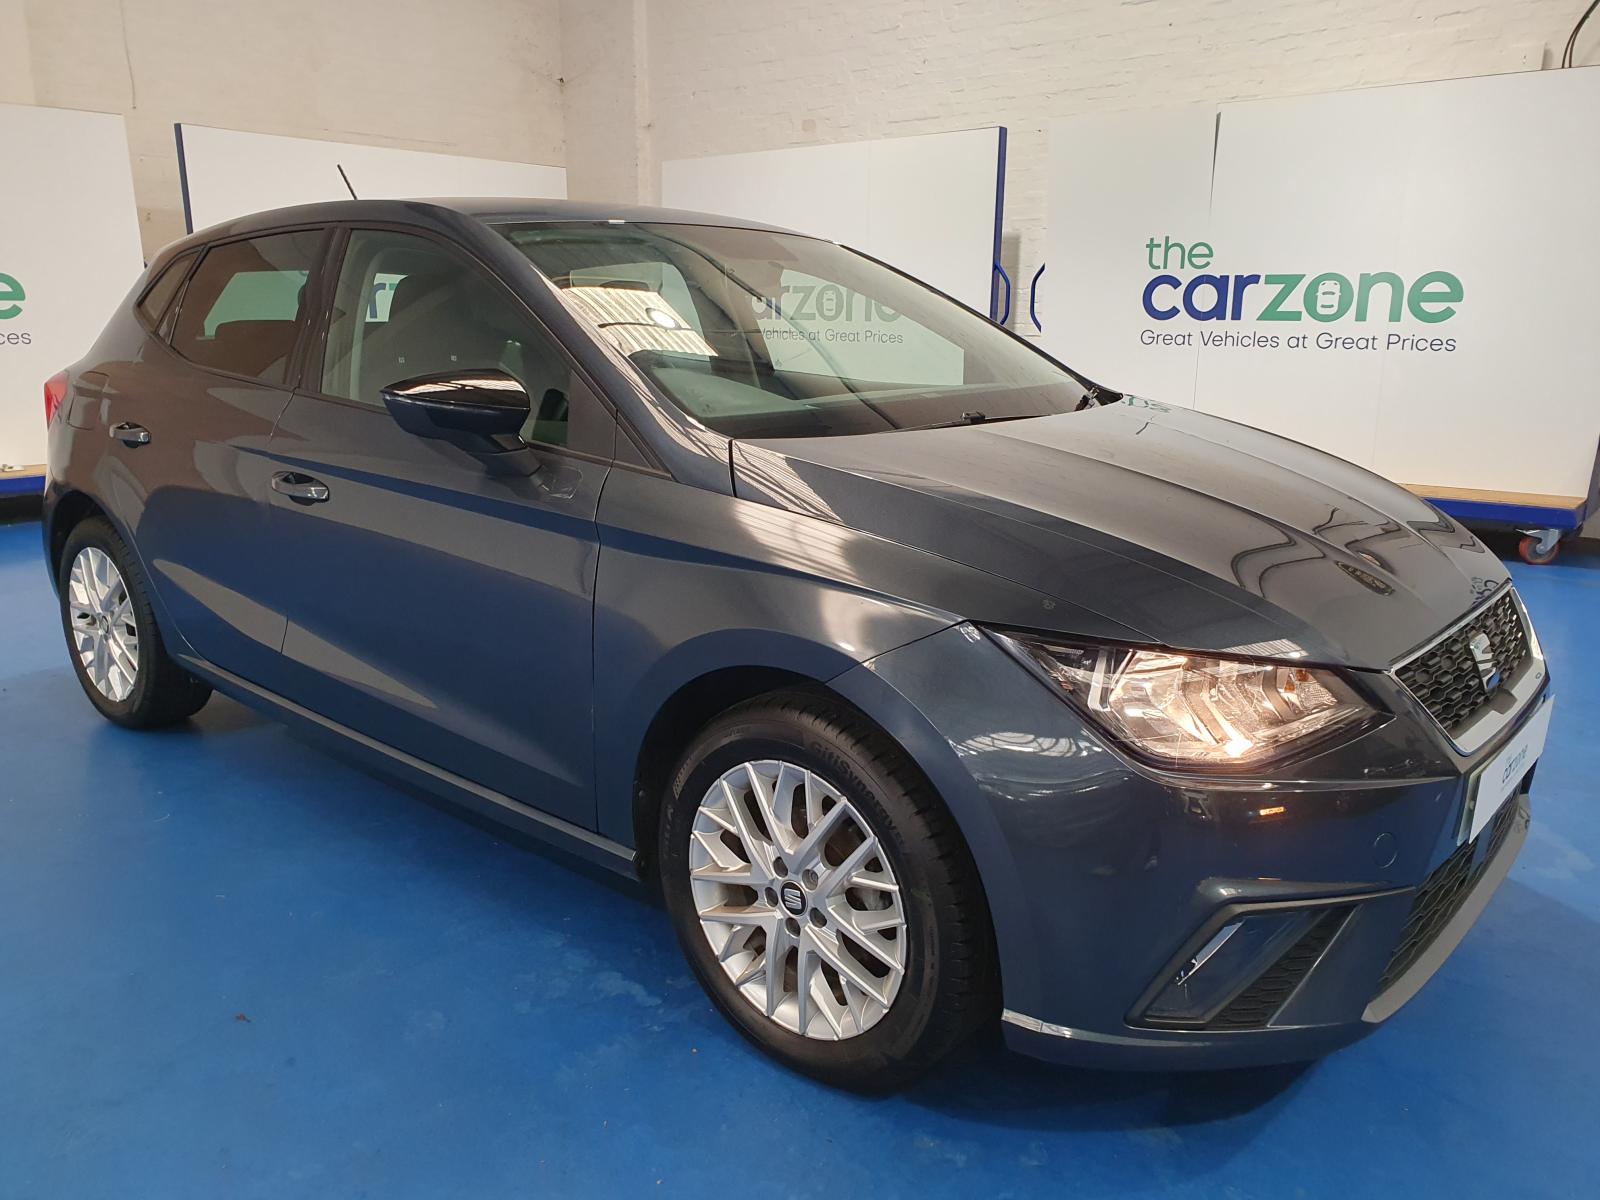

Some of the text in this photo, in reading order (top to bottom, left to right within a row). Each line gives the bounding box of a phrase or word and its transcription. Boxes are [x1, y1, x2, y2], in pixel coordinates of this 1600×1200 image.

[1146, 236, 1213, 270] the
[1142, 271, 1464, 323] carzone
[808, 330, 821, 341] at
[824, 329, 861, 342] Great
[865, 330, 904, 344] Prices
[1140, 329, 1457, 352] Great Vehicles at Great Prices
